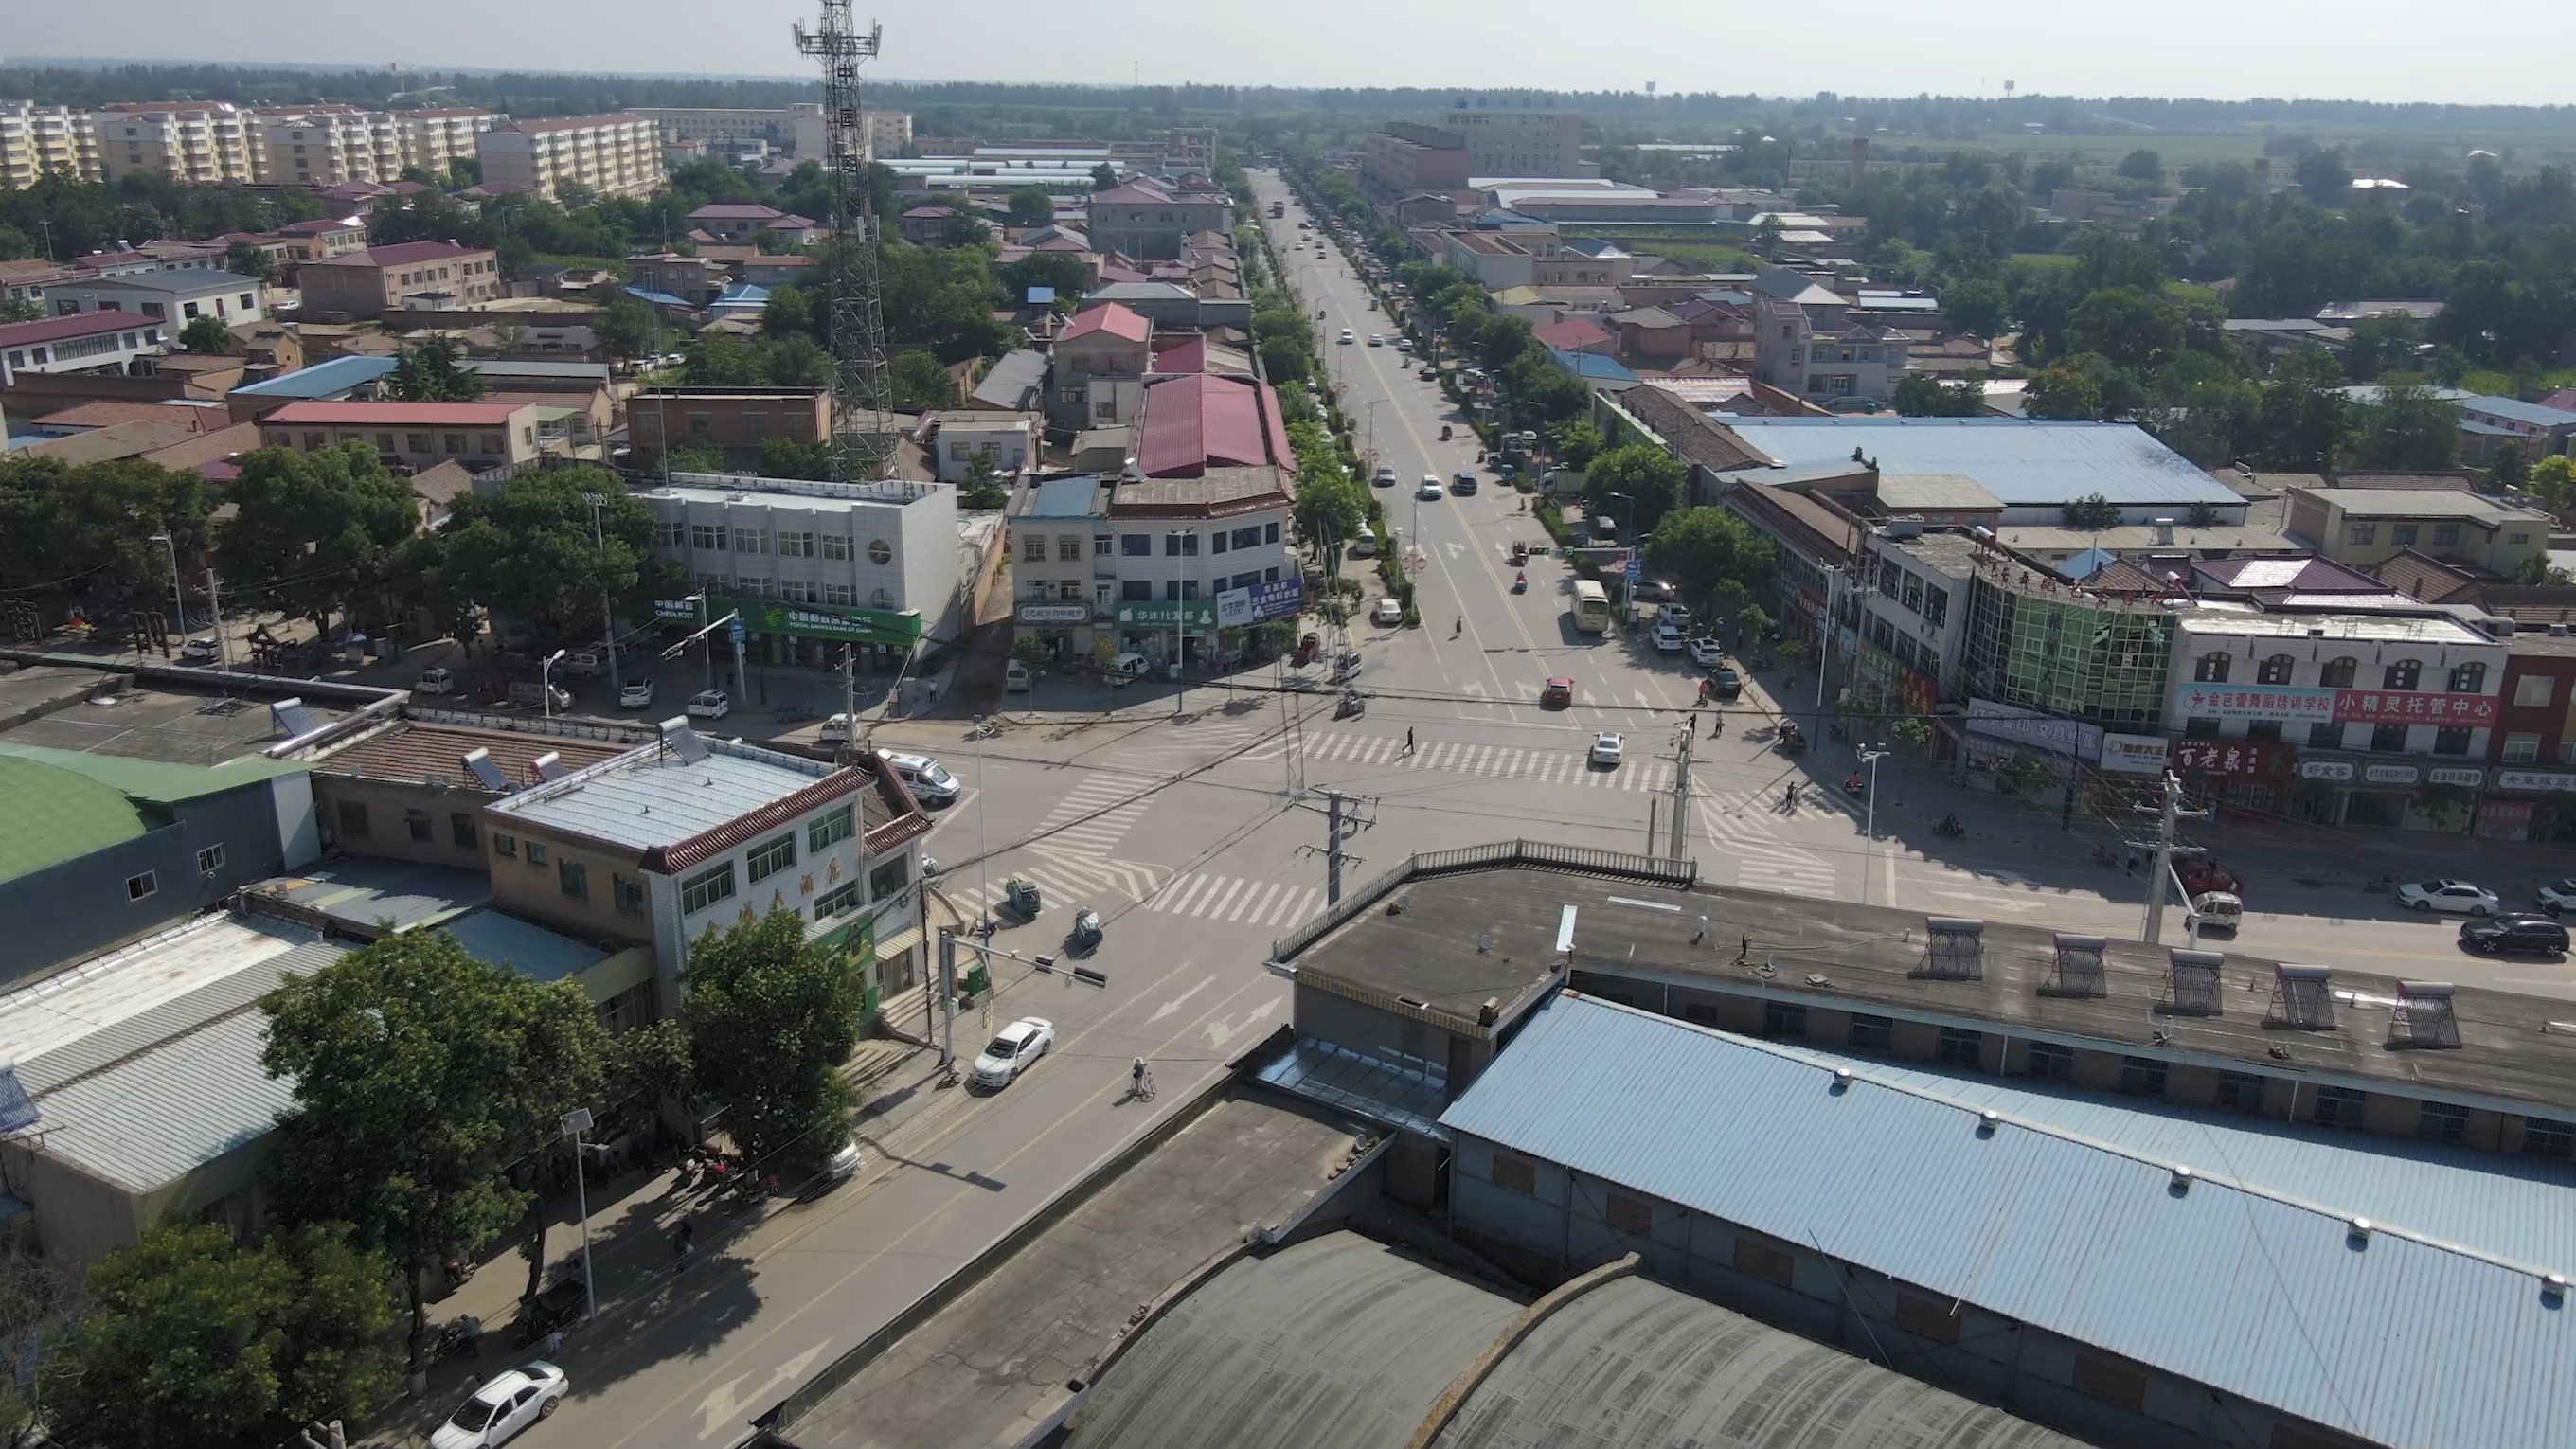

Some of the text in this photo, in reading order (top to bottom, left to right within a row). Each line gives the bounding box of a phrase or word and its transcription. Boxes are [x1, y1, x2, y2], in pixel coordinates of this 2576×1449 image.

[654, 599, 694, 611] 中国邮政
[655, 609, 694, 619] CHINA POST
[2208, 691, 2331, 711] 金芭蕾舞蹈培训学校
[2338, 693, 2492, 717] 小精灵托管中心
[1972, 707, 2030, 733] 打字复印
[2178, 746, 2242, 772] 百老泉
